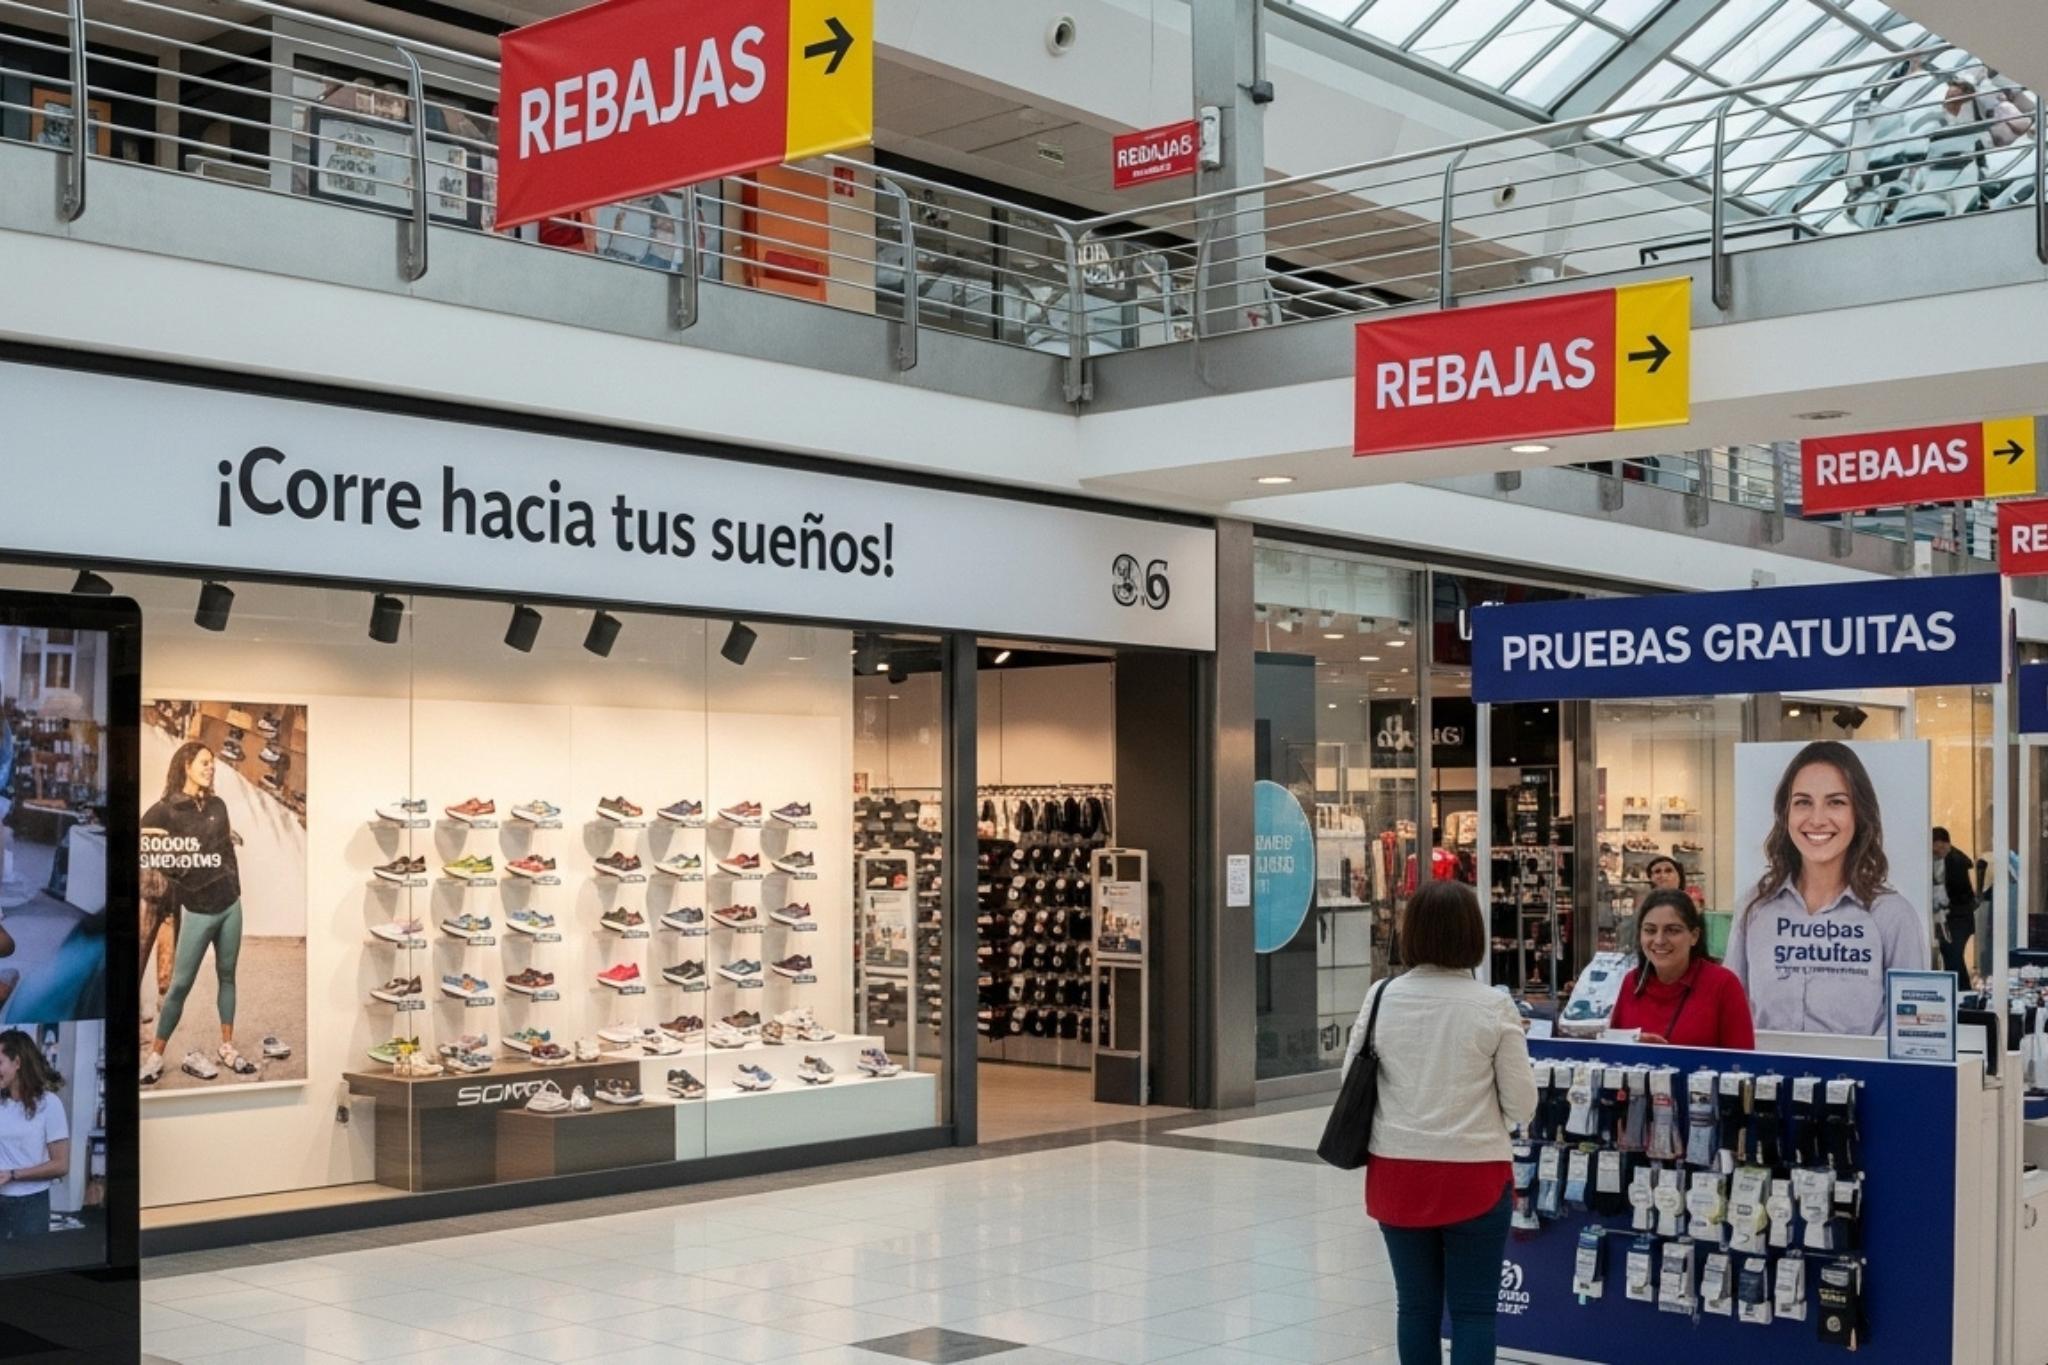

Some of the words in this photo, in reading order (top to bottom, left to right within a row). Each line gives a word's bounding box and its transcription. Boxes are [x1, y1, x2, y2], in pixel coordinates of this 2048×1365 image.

[519, 25, 766, 159] REBAJAS
[1376, 337, 1596, 410] REBAJAS
[1816, 438, 1968, 486] REBAJAS
[218, 446, 422, 530] ¡Corre
[442, 465, 597, 549] hacia
[611, 494, 696, 558] tus
[711, 511, 894, 578] sueños!
[1502, 625, 1691, 672] PRUEBAS
[1703, 611, 1956, 662] GRATUITAS
[1777, 917, 1864, 941] Pruebas
